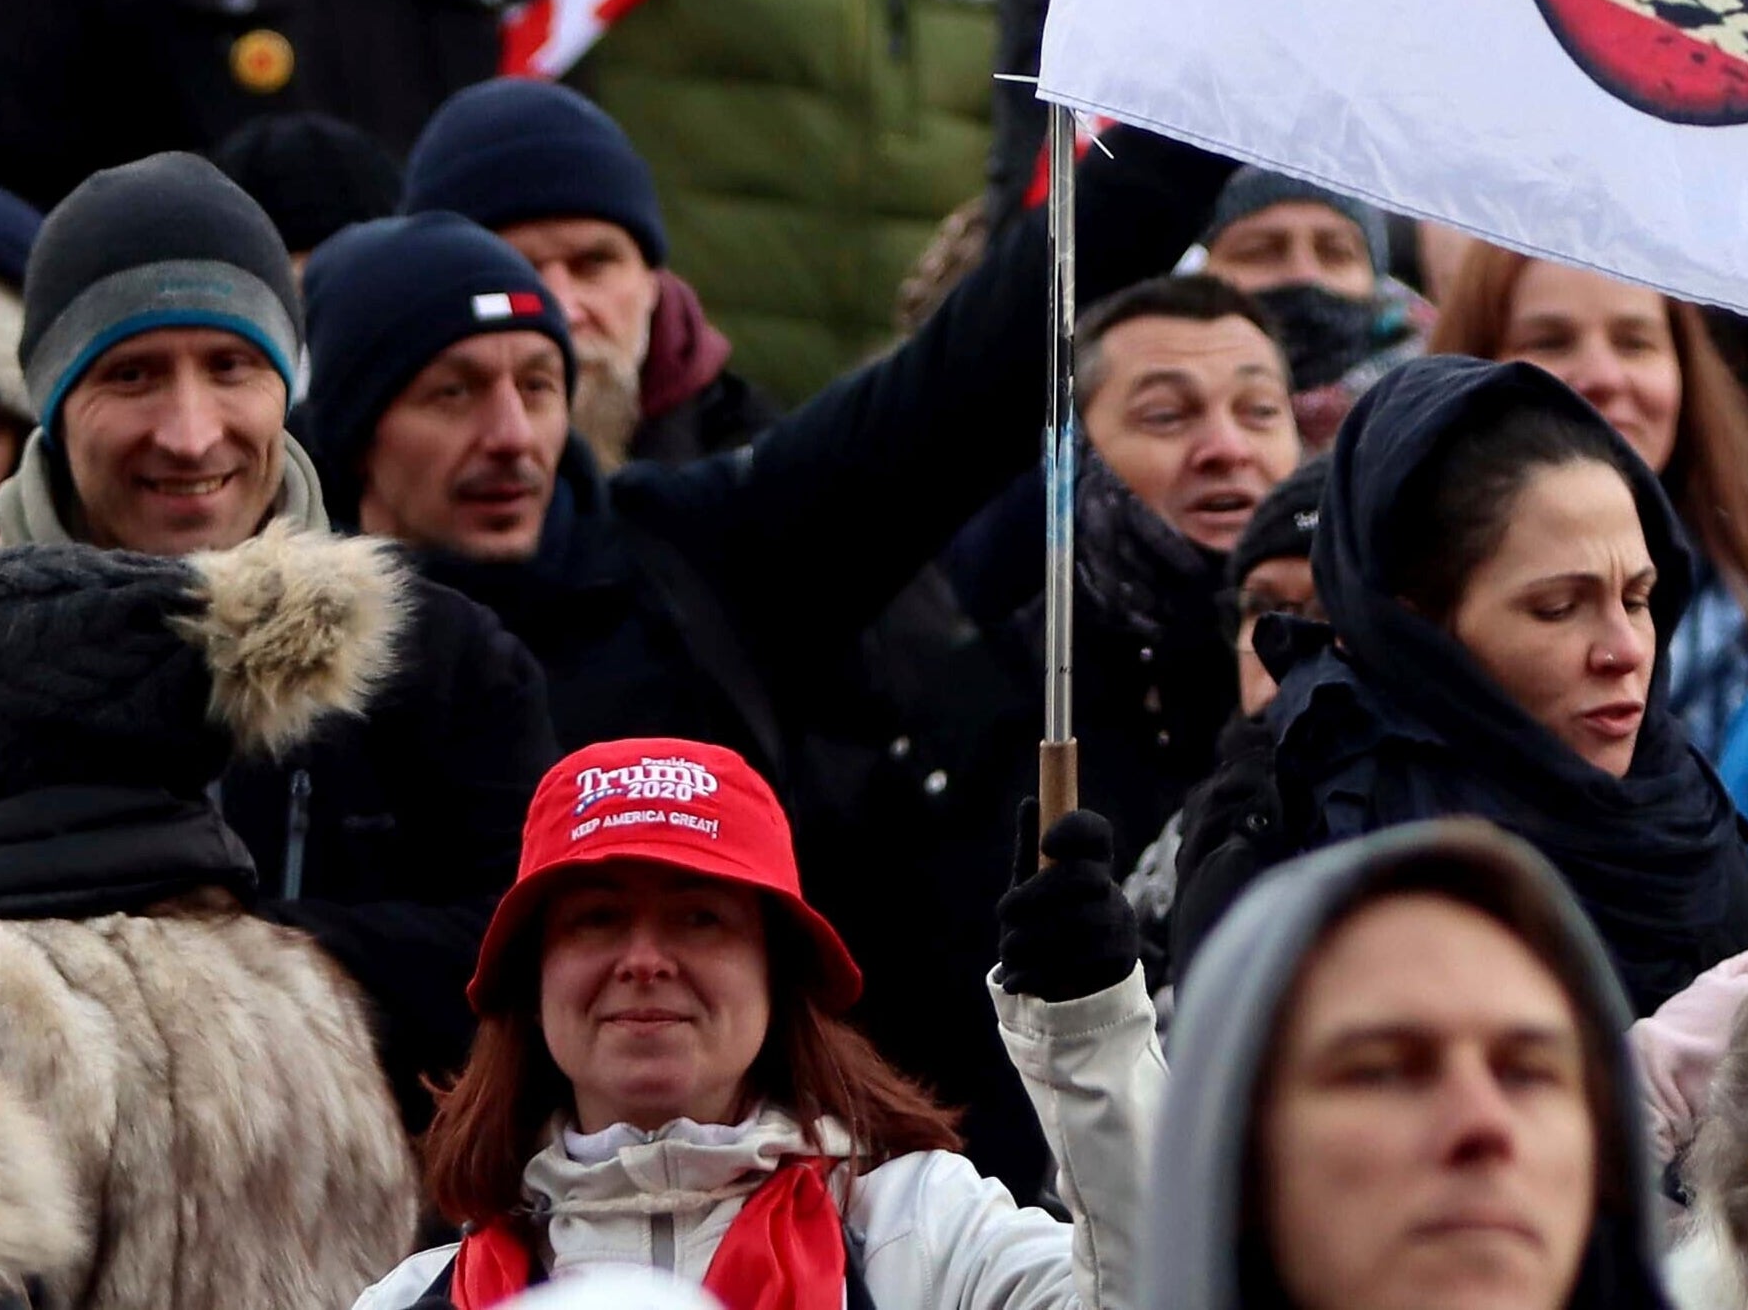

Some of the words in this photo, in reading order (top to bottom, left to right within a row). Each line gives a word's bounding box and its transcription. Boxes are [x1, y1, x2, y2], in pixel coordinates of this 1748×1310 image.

[577, 765, 718, 798] Trump
[627, 781, 693, 801] 2020
[571, 817, 600, 840] KEEP
[603, 810, 666, 827] AMERICA
[669, 811, 720, 839] GREAT!
